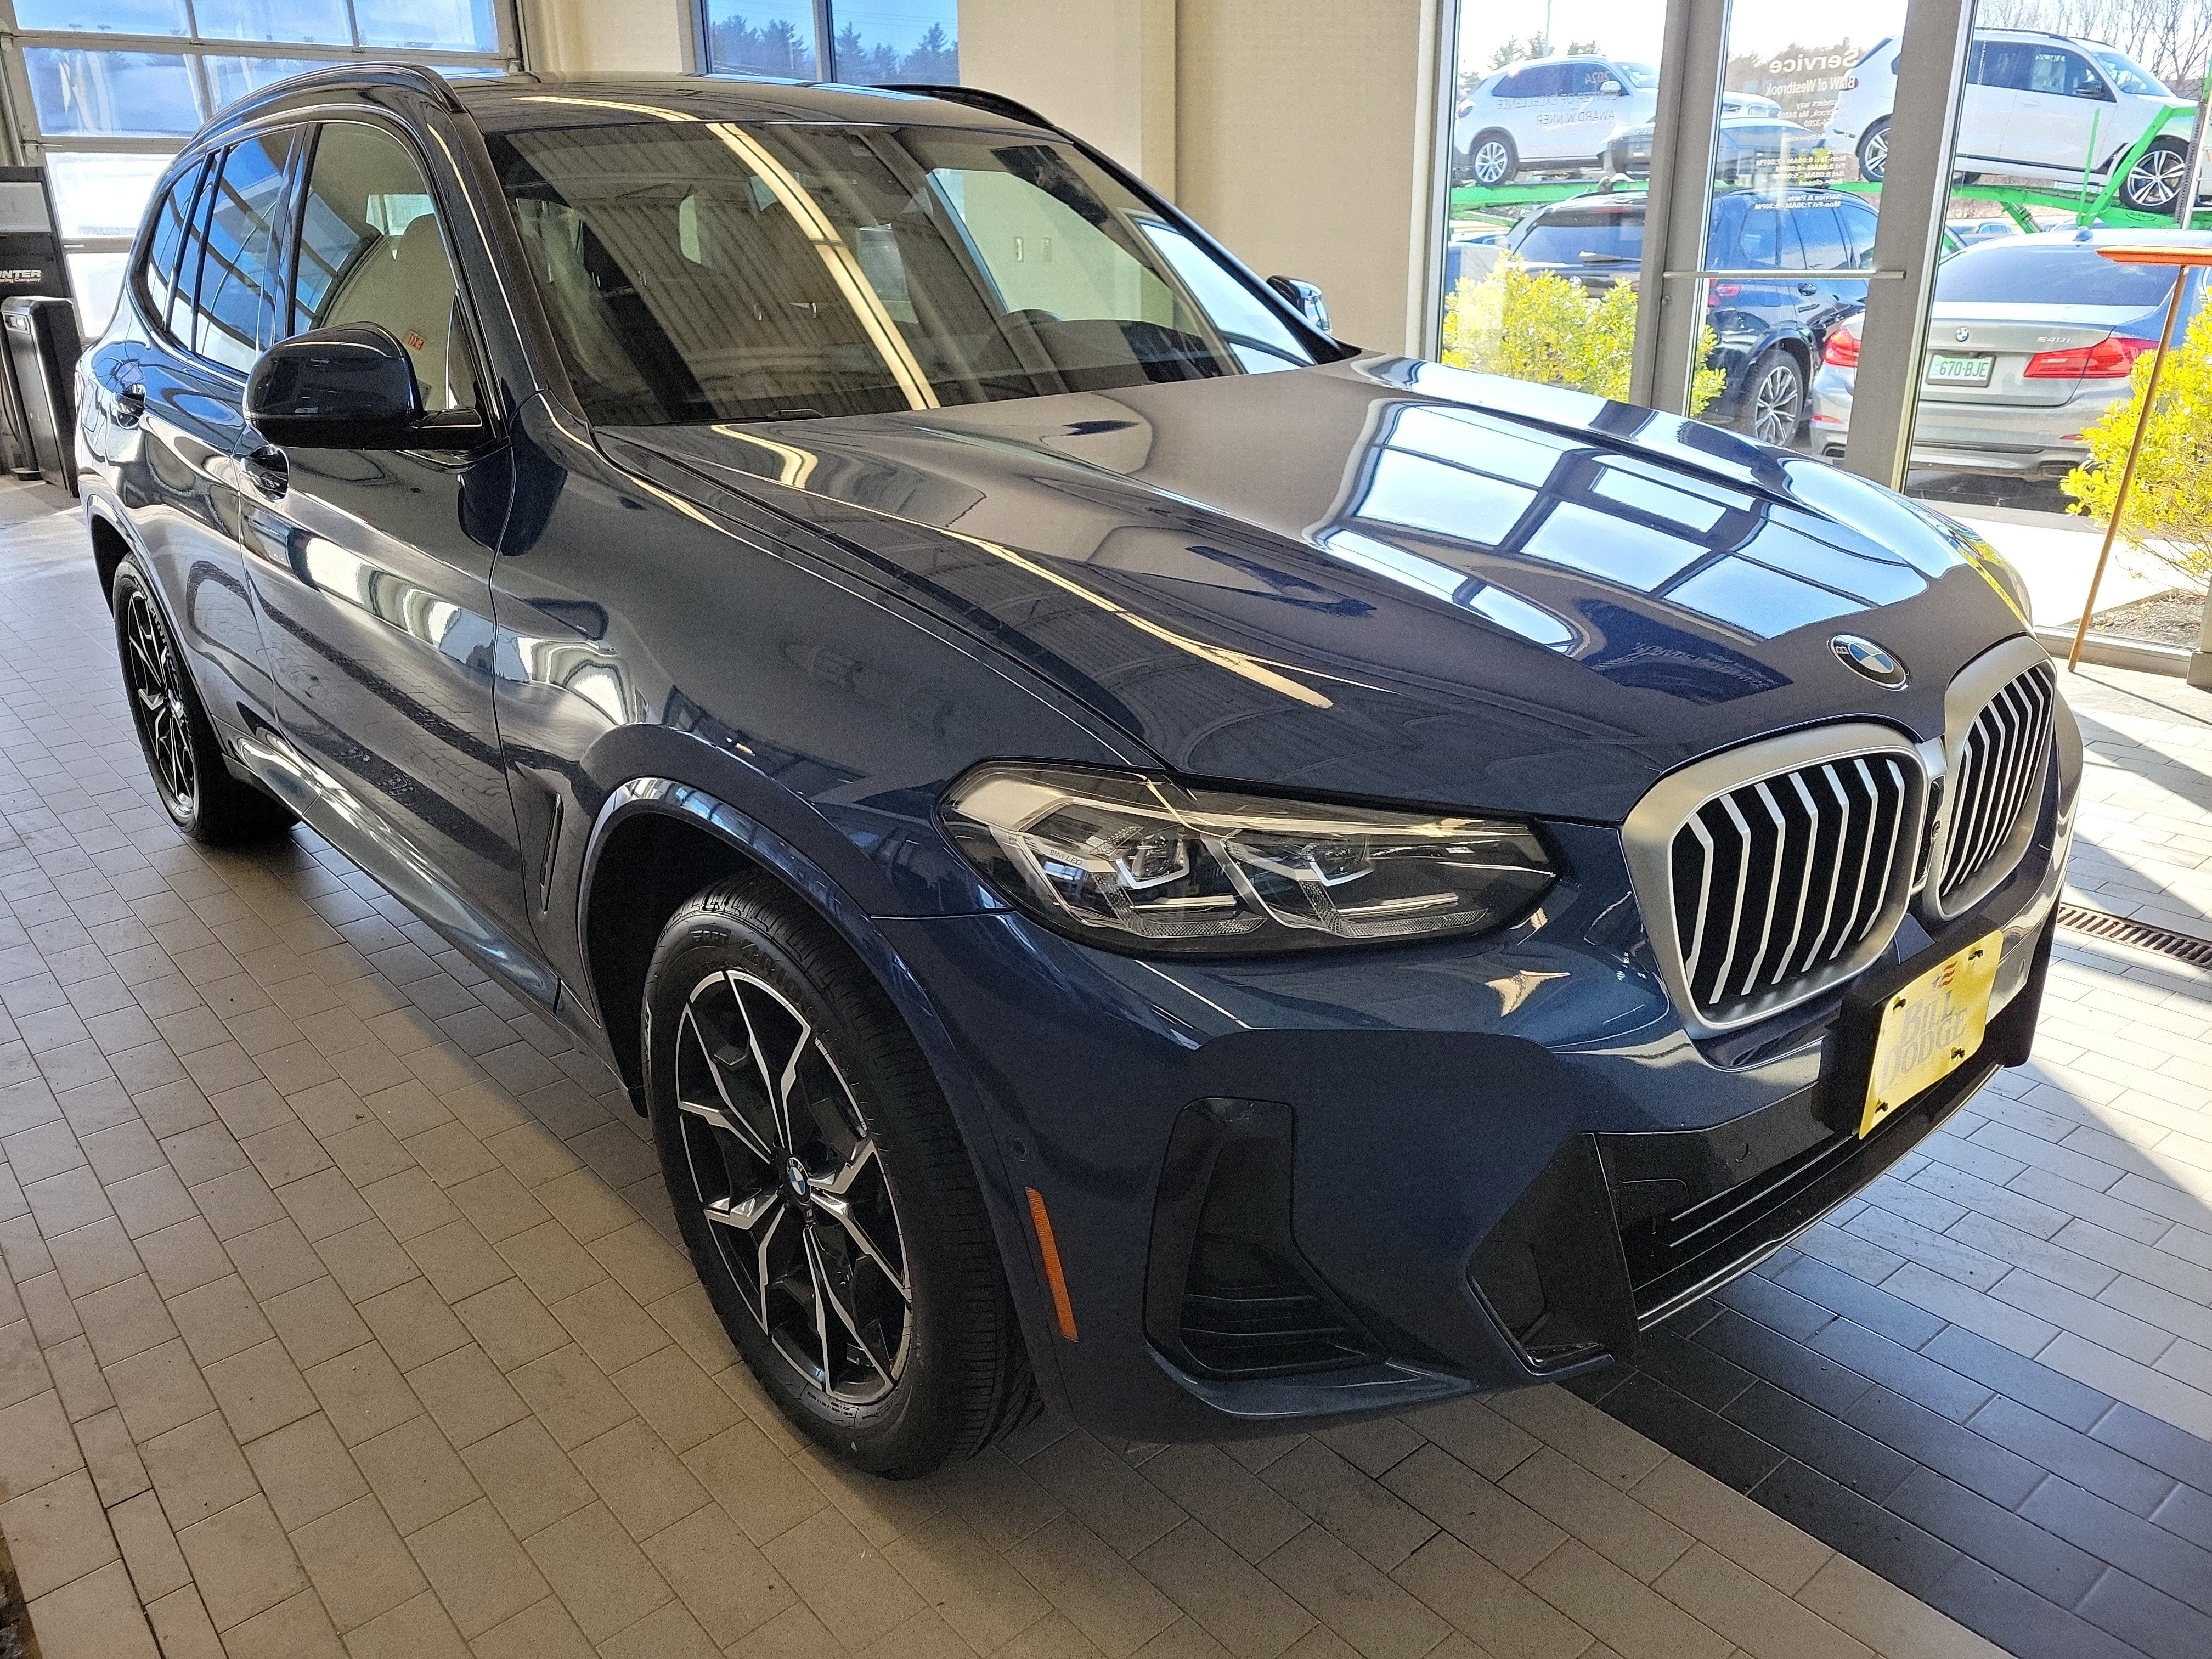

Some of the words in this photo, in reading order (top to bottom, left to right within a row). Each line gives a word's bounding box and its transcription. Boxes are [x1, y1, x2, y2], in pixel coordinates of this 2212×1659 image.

[1050, 849, 1065, 859] BMW
[1065, 856, 1082, 865] LED
[1901, 989, 1956, 1046] BILL
[1878, 1007, 1968, 1096] DODGE
